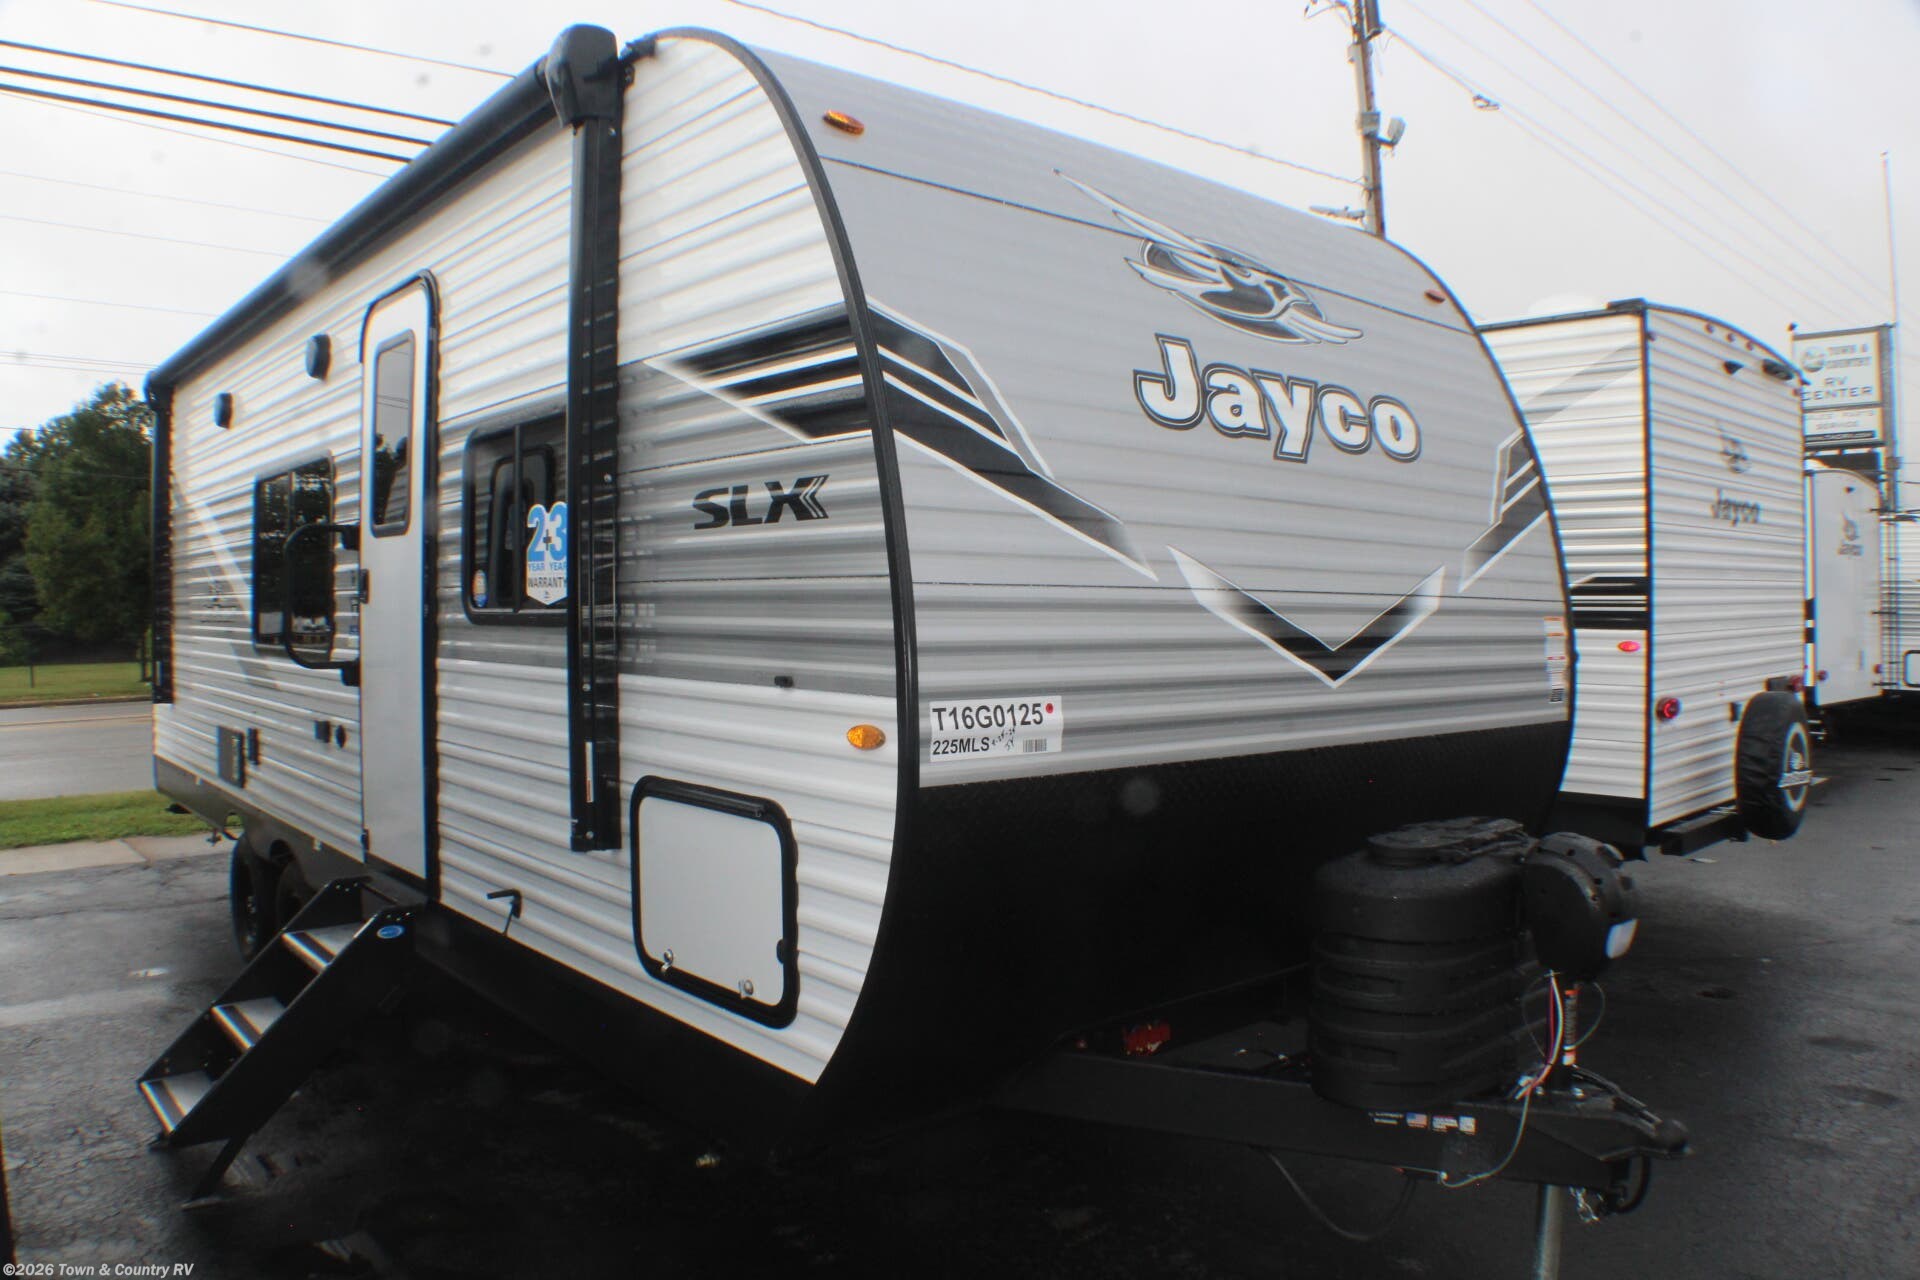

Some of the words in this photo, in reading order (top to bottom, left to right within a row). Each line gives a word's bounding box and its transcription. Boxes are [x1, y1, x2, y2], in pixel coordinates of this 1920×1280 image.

[1133, 333, 1422, 463] Jayco
[1801, 385, 1873, 402] CENTER
[692, 474, 829, 529] SLX
[931, 702, 1044, 731] T16G0125
[932, 736, 990, 756] 225MLS
